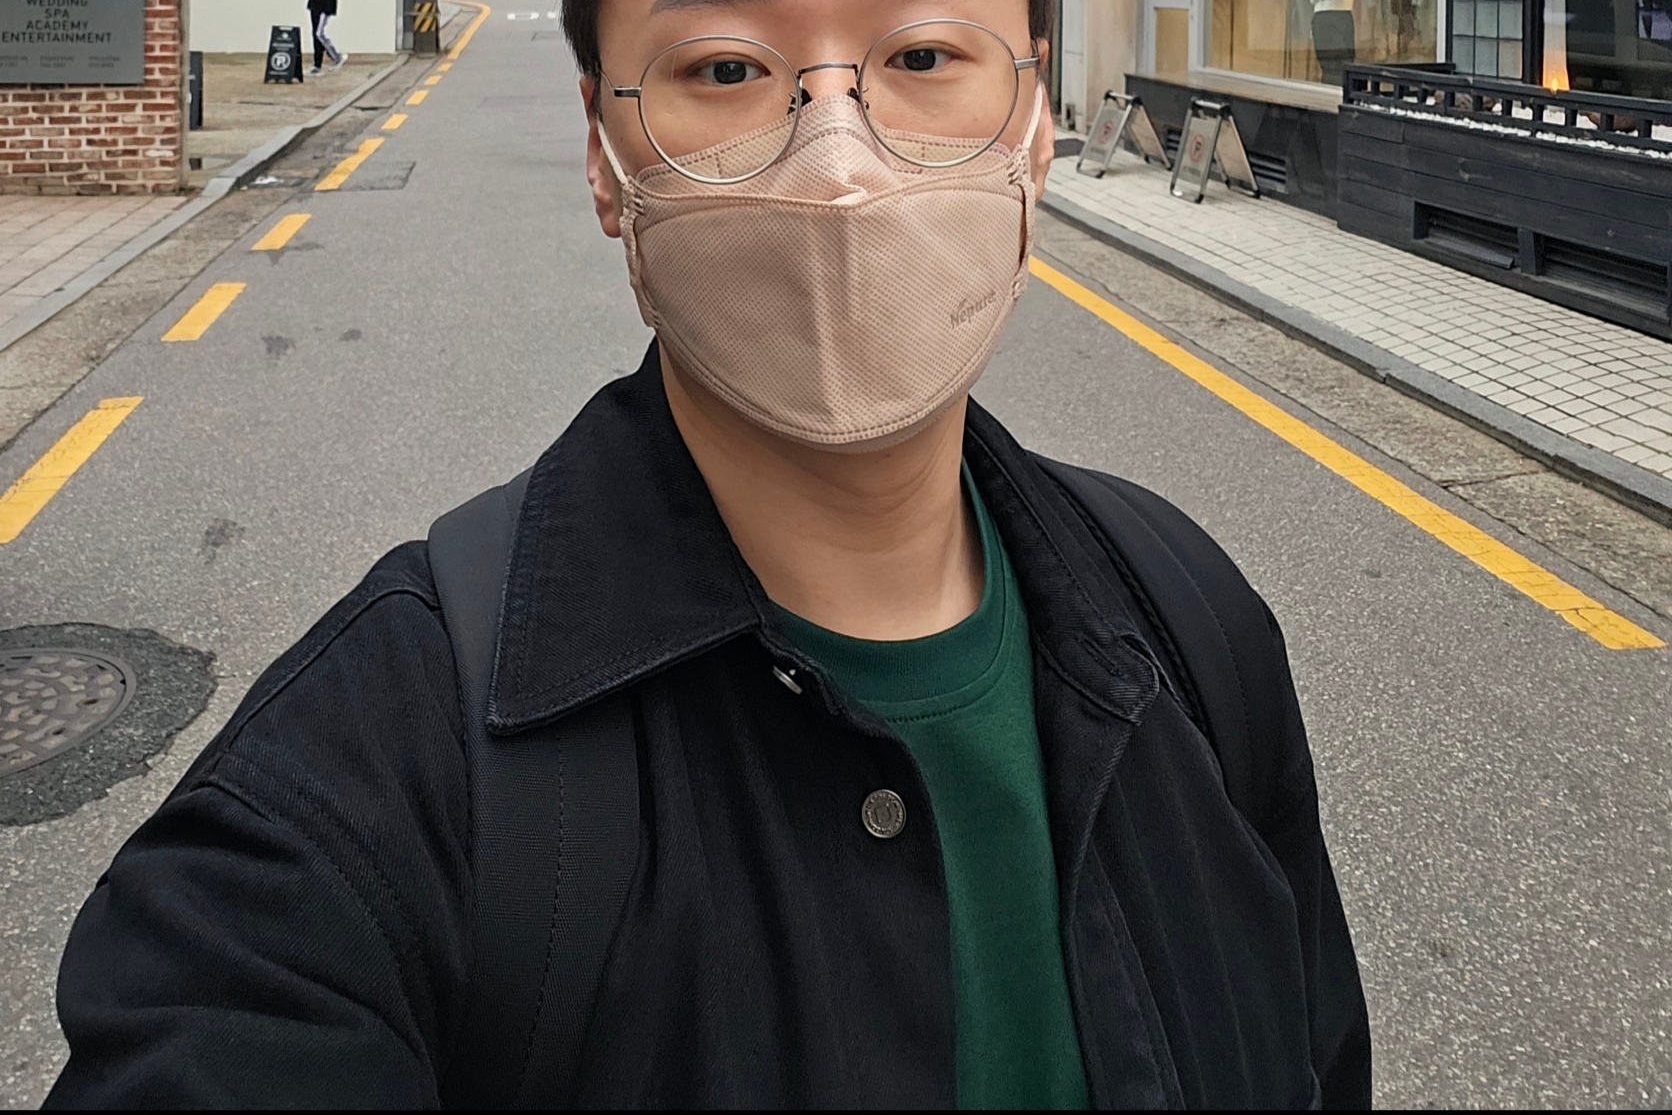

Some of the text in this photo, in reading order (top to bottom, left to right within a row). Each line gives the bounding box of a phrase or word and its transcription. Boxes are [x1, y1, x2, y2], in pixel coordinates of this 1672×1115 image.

[44, 8, 70, 19] SPA
[26, 20, 89, 31] ACADEMY
[1, 31, 112, 43] ENTERTAINMENT
